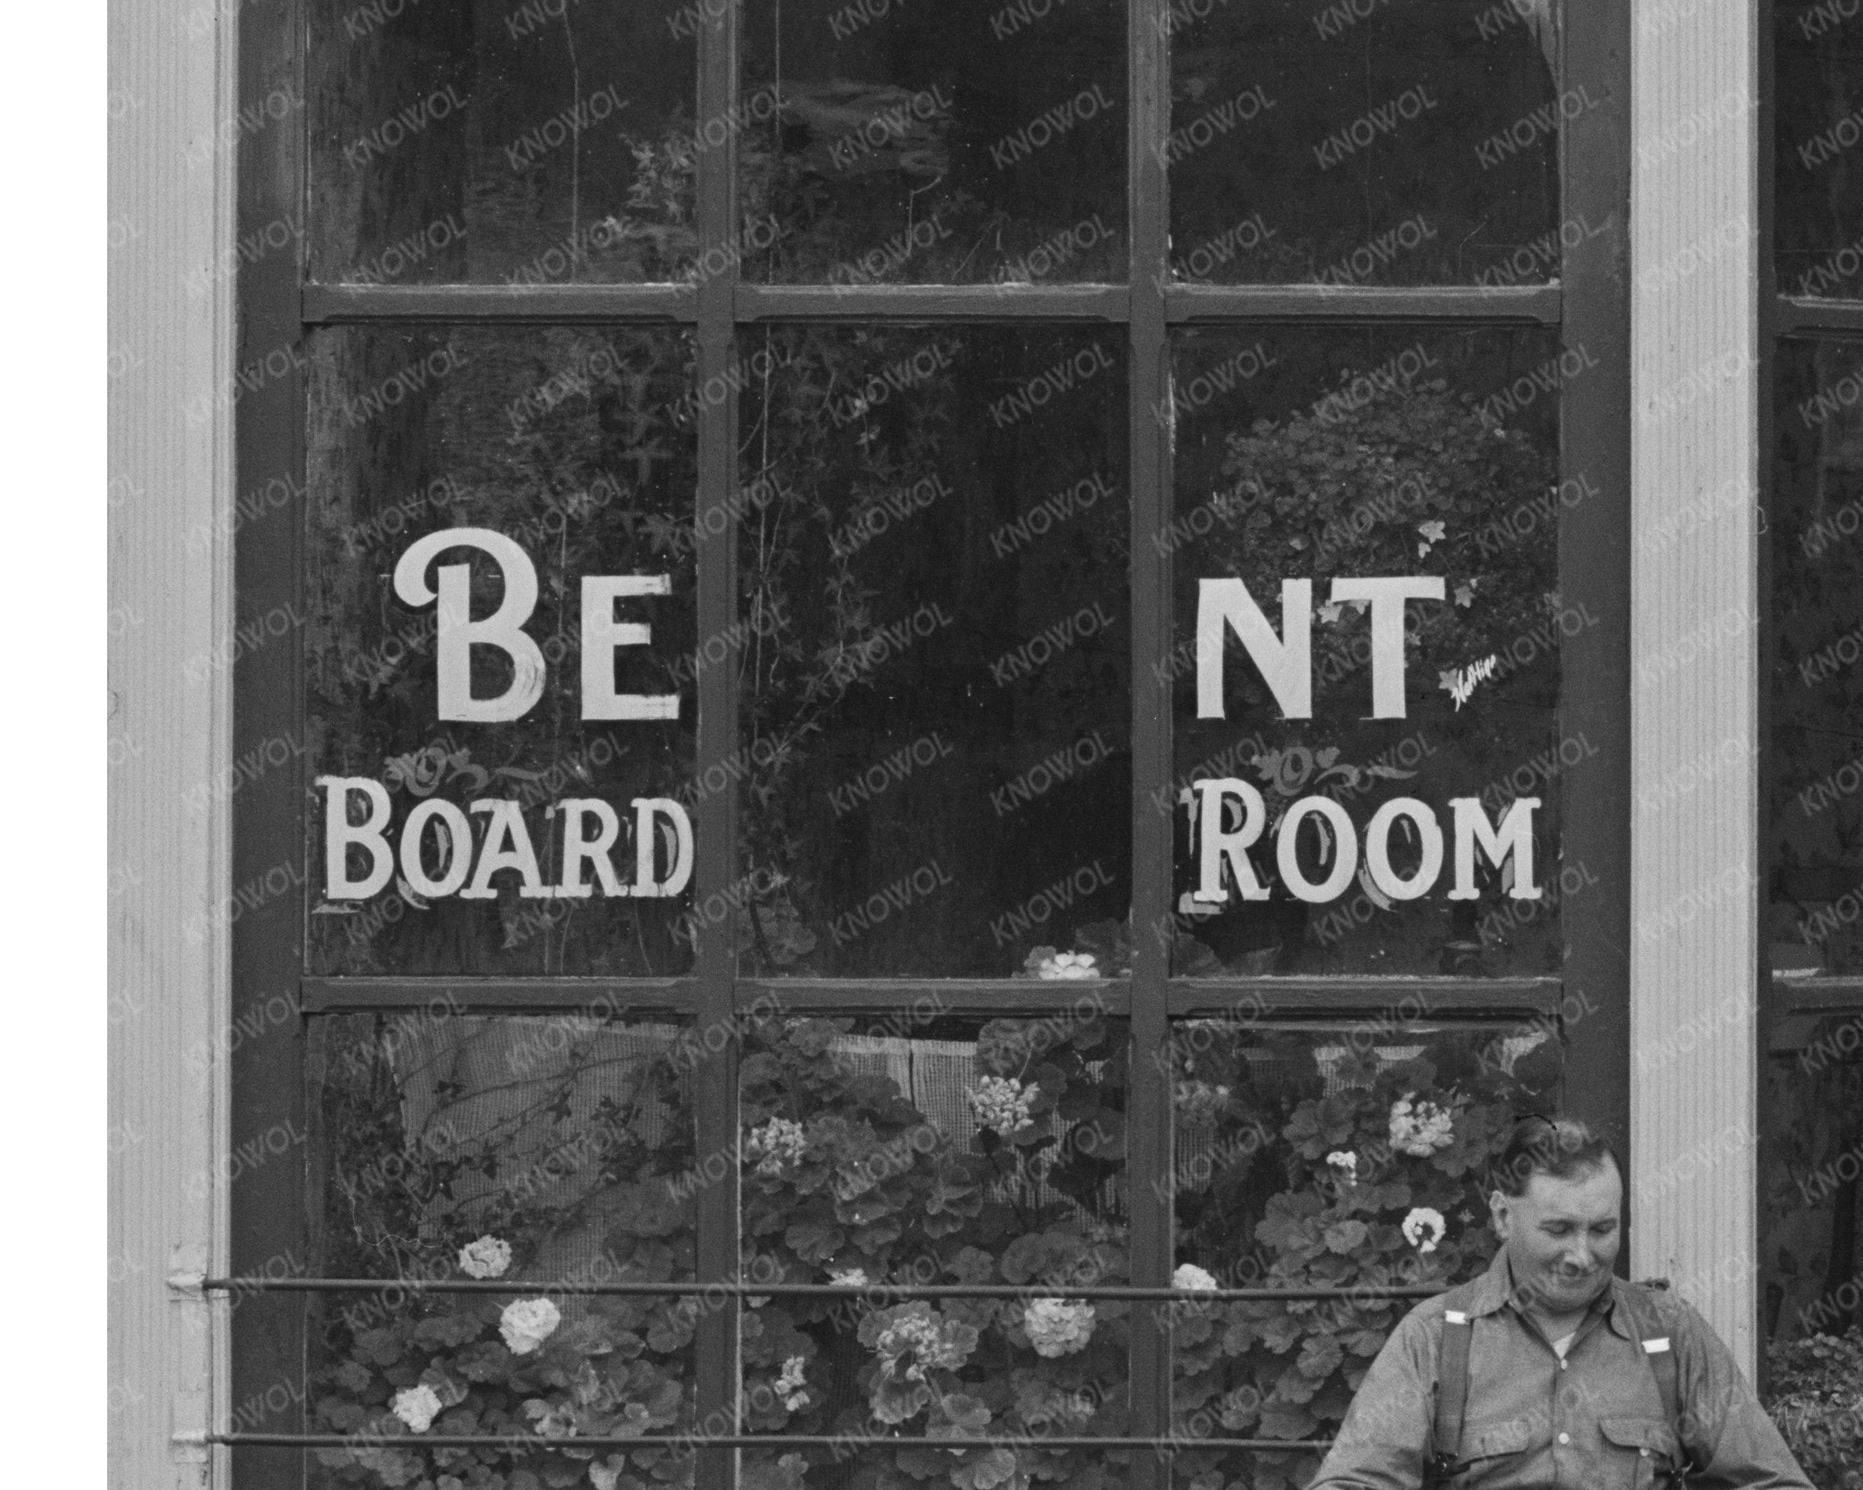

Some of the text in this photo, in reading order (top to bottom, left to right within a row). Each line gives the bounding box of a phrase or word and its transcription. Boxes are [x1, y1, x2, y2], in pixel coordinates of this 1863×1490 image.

[394, 528, 1445, 722] BE NT
[317, 776, 1541, 902] BOARD ROOM
